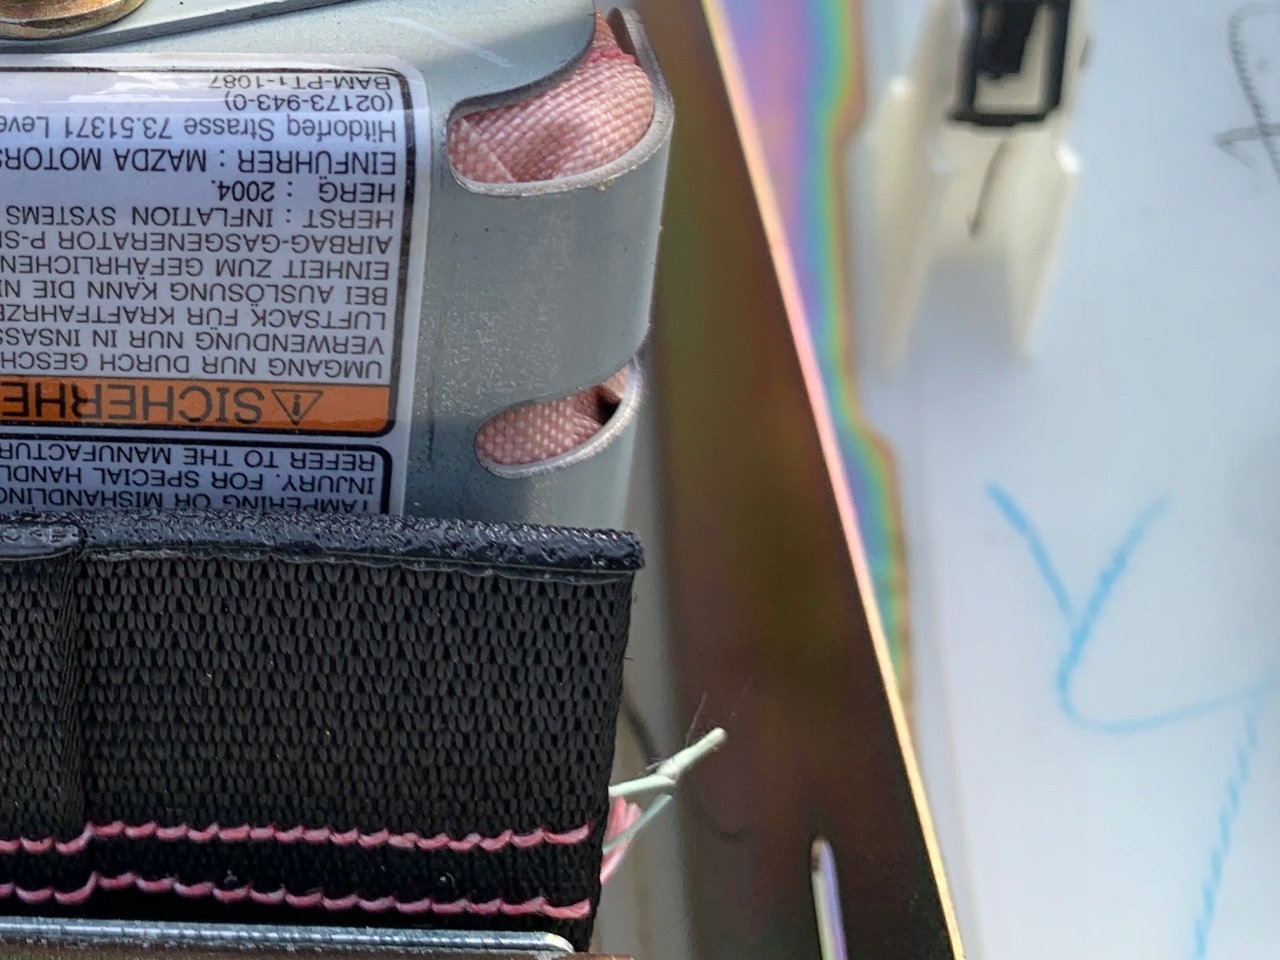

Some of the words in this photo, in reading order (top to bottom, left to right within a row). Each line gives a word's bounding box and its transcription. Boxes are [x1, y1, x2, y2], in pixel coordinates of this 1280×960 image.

[224, 90, 393, 112] (02173-943-0)
[65, 116, 172, 139] 73.51371
[184, 118, 274, 142] Strasse
[113, 148, 206, 172] MAZDA
[238, 149, 396, 180] EINFÜHRER
[211, 180, 275, 202] 2004.
[318, 182, 396, 203] HERG
[6, 205, 116, 226] SYSTEMS
[132, 206, 273, 228] INFLATION
[302, 209, 394, 229] HERST
[58, 231, 392, 254] AIRBAG-GASGENERATOR
[0, 255, 204, 280] GEFÄHRLICHEN
[216, 258, 272, 278] ZUM
[282, 260, 390, 280] EINHEIT
[32, 280, 75, 299] DIE
[88, 281, 157, 300] KANN
[170, 282, 334, 306] AUSLÖSUNG
[345, 286, 388, 306] BEI
[187, 307, 238, 330] FÜR
[251, 309, 386, 330] LUFTSACK
[92, 330, 117, 348] IN
[129, 330, 184, 349] NUR
[196, 332, 384, 355] VERWENDUNG
[100, 354, 190, 373] DURCH
[202, 356, 256, 374] NUR
[268, 358, 382, 379] UMGANG
[183, 448, 233, 466] THE
[244, 450, 279, 468] TO
[290, 452, 374, 472] REFER
[92, 468, 200, 488] SPECIAL
[211, 472, 263, 490] FOR
[276, 474, 374, 494] INJURY.
